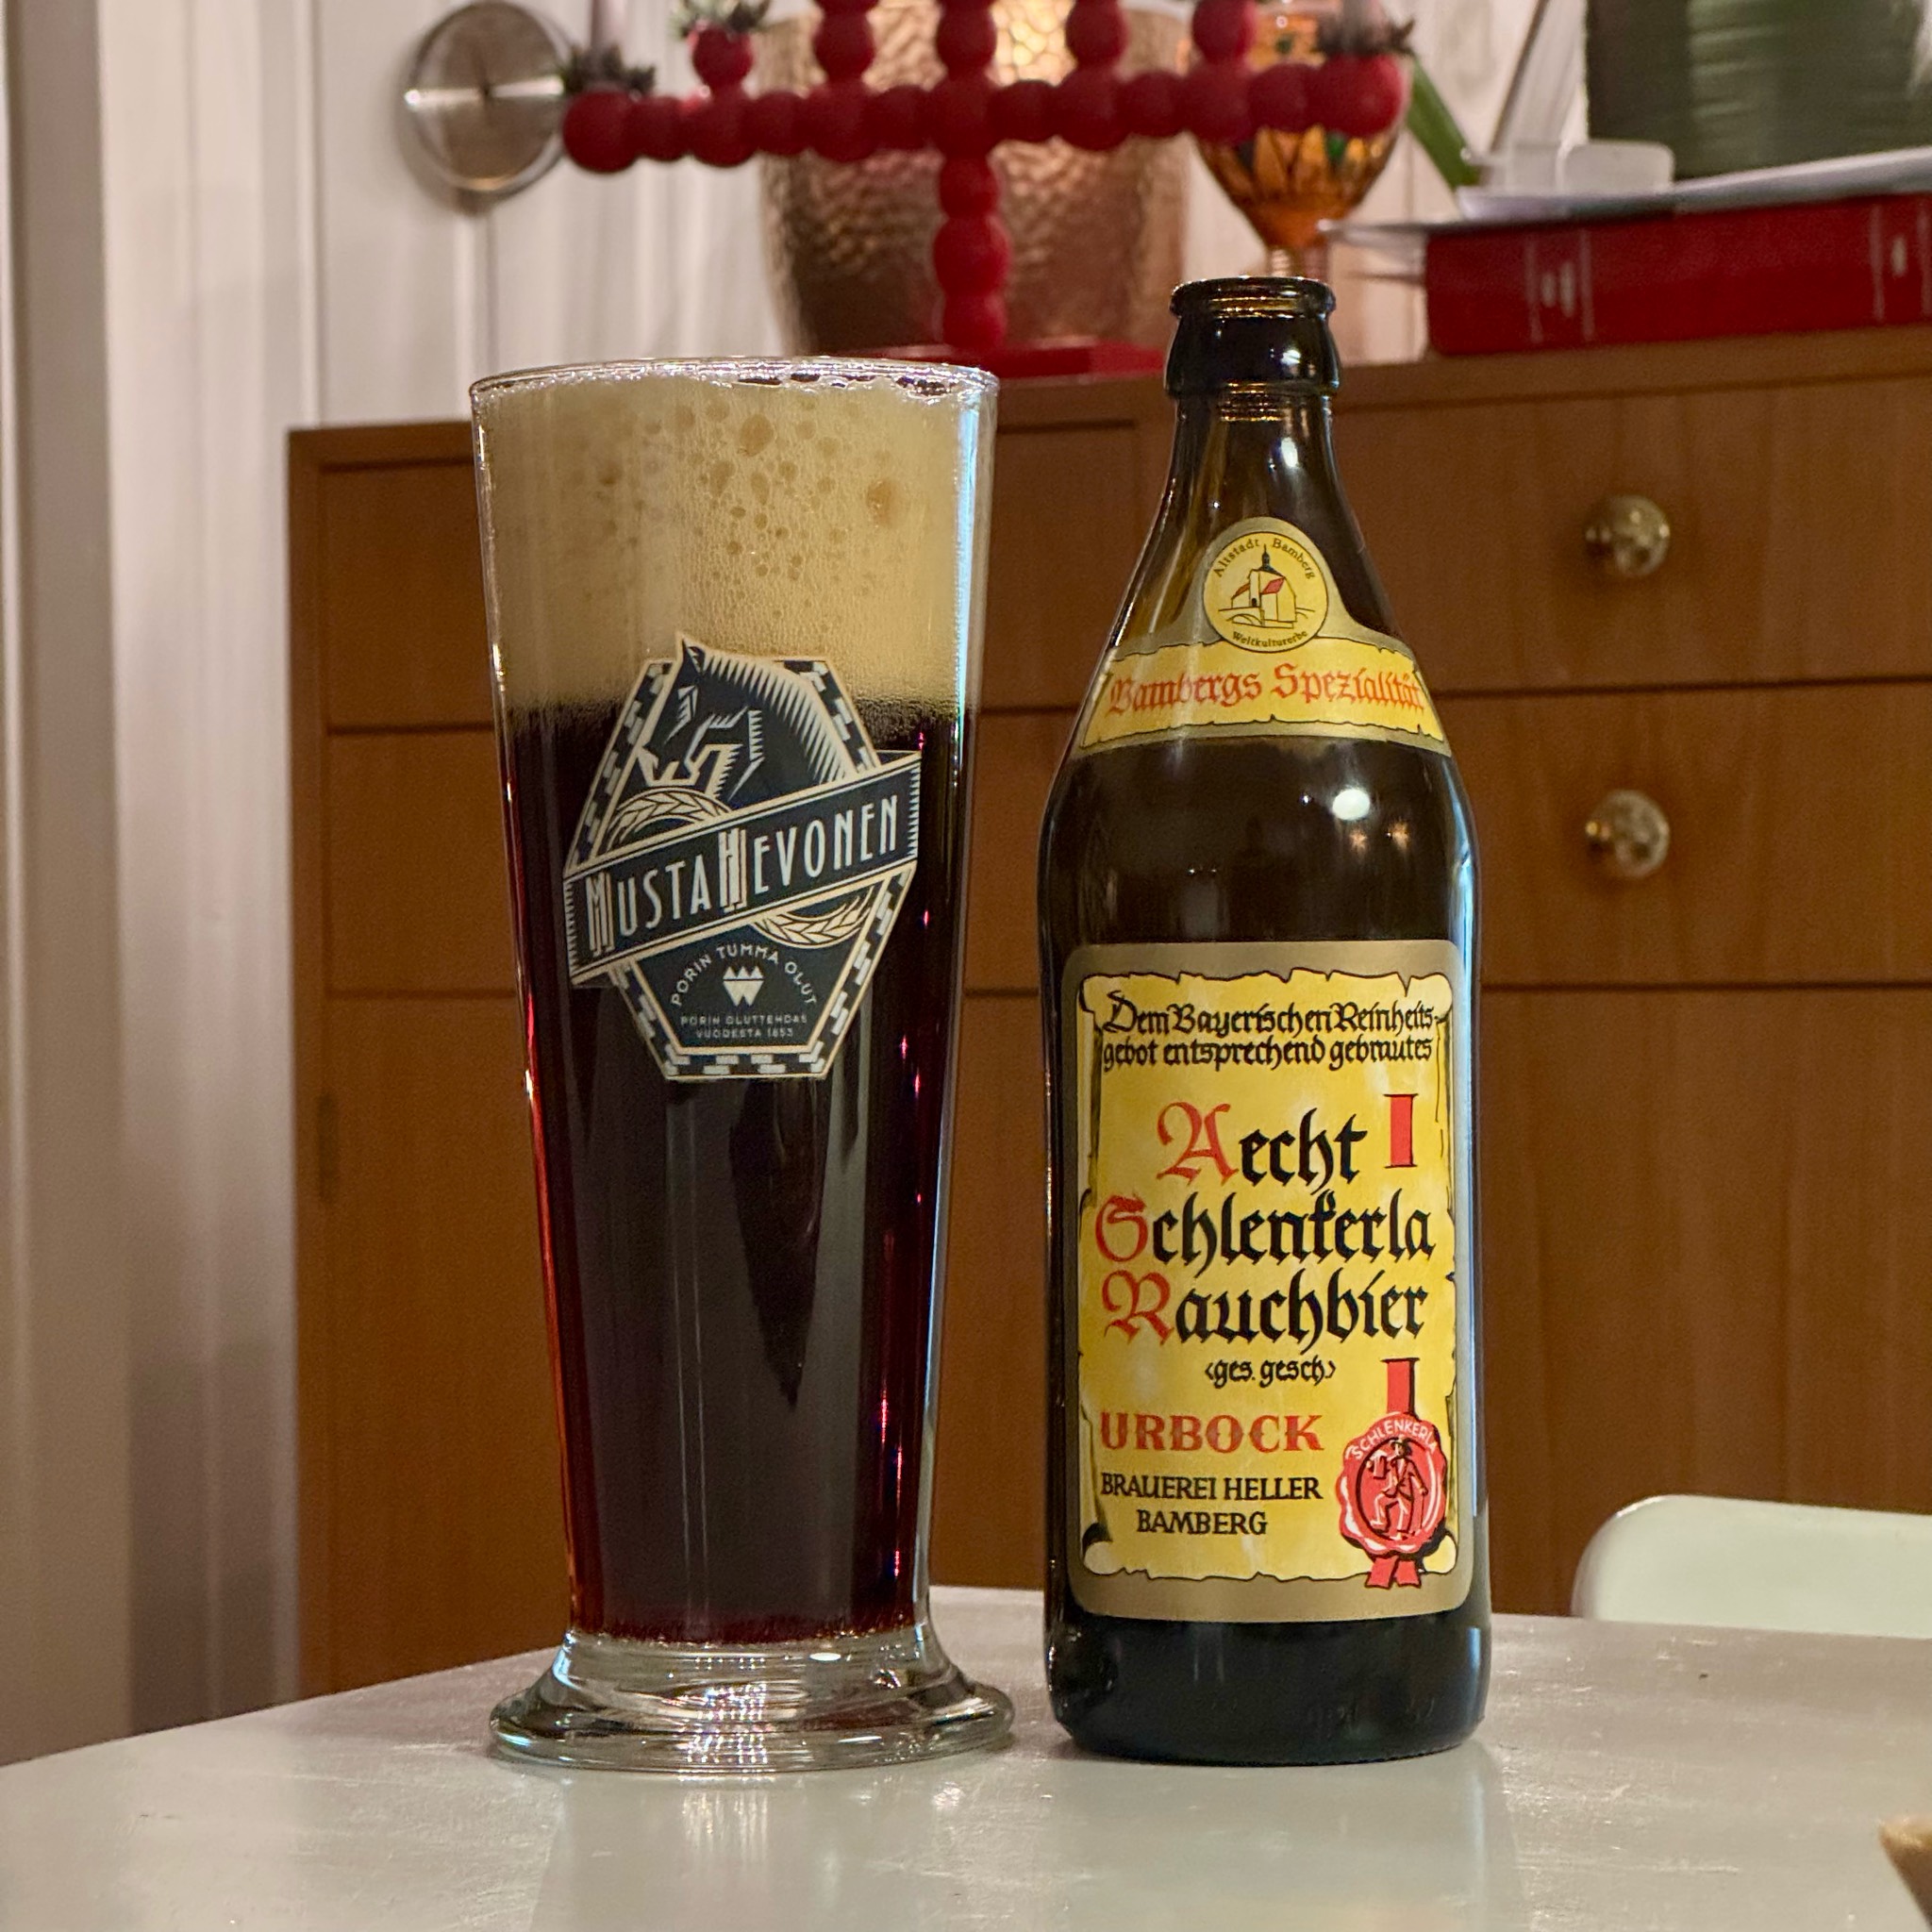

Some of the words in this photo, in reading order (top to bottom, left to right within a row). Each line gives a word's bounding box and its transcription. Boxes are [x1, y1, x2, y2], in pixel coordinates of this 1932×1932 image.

[1213, 538, 1259, 578] Altstadt
[1272, 537, 1315, 579] Bamberg
[1232, 630, 1307, 648] Weltkulturerbe
[1105, 670, 1261, 717] Bambergs
[1272, 662, 1424, 710] Spezialität
[671, 953, 712, 1008] PORIN
[716, 943, 779, 965] TUMMA
[784, 960, 818, 1005] OLUT
[680, 1015, 721, 1025] PORIN
[696, 1027, 762, 1039] VUODESTA
[767, 1026, 794, 1039] 1853
[1102, 990, 1170, 1035] Dem
[1166, 1001, 1332, 1039] Bayerischen
[1103, 1036, 1158, 1073] gebot
[1163, 1034, 1325, 1073] entsprechend
[1329, 1033, 1433, 1072] gebrautes
[1156, 1101, 1368, 1195] Aecht
[1094, 1189, 1437, 1279] Schlenkerla
[1102, 1267, 1429, 1356] Rauchbier
[1100, 1411, 1324, 1454] URBOCK
[1349, 1419, 1439, 1460] SCHLENKERLA
[1101, 1473, 1217, 1500] BRAUEREI
[1224, 1476, 1324, 1501] HELLER
[1137, 1509, 1268, 1536] BAMBERG
